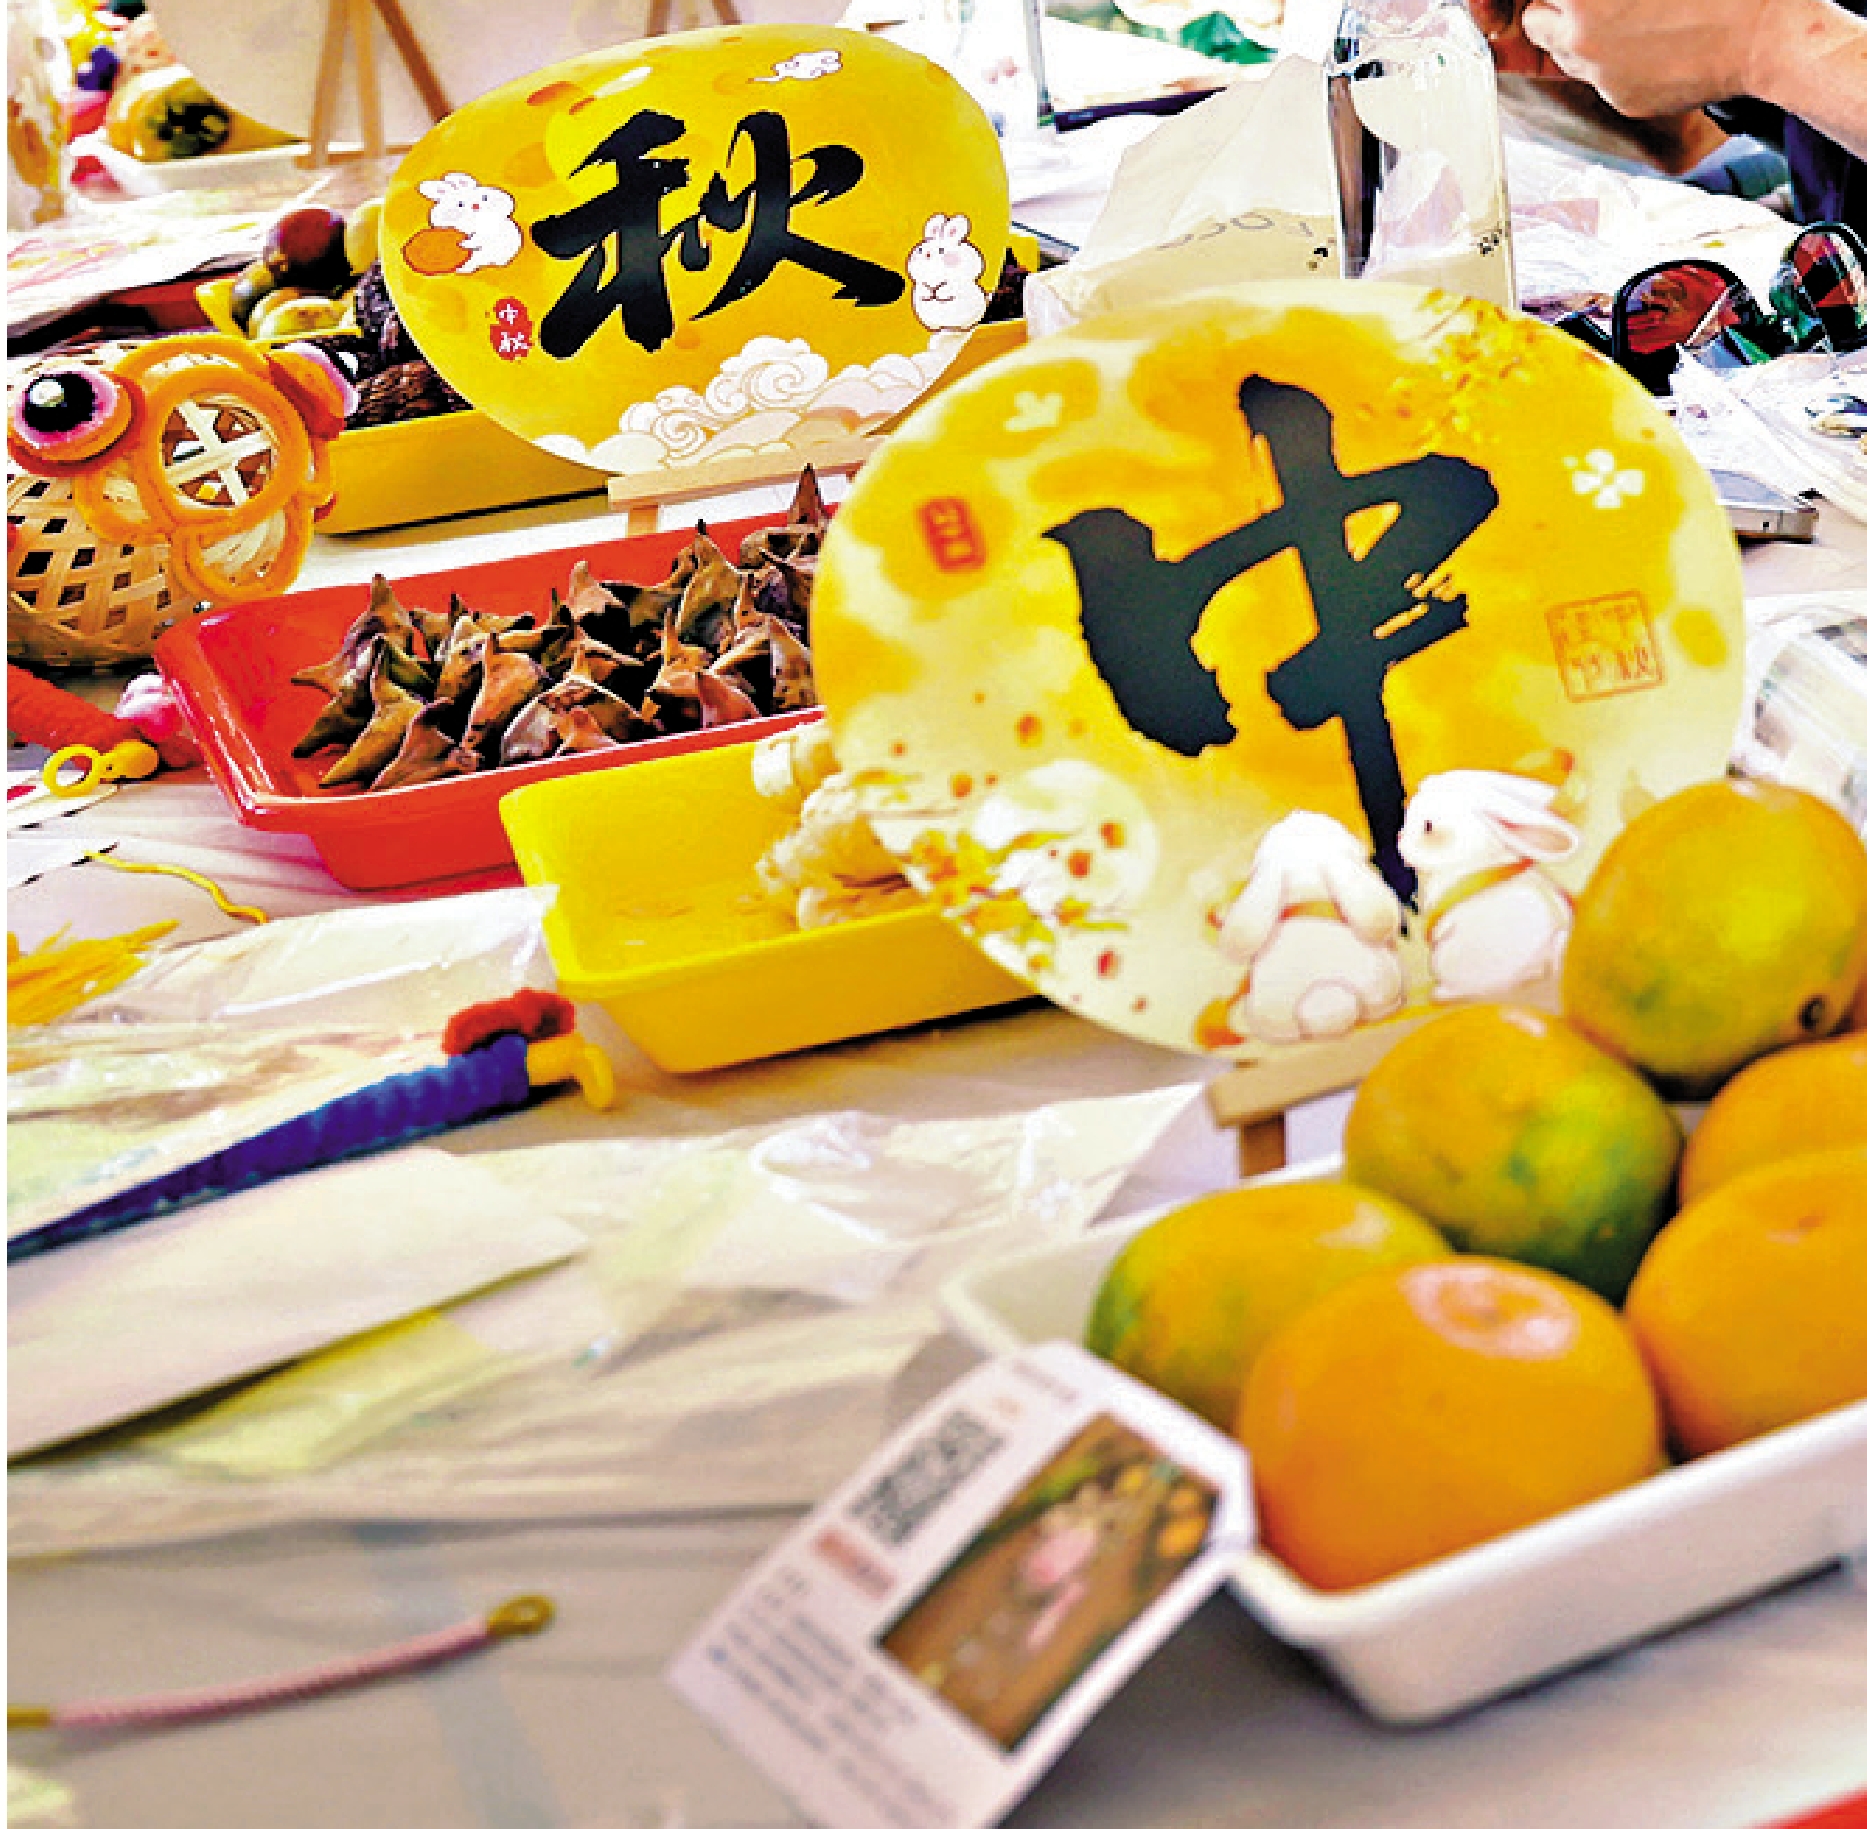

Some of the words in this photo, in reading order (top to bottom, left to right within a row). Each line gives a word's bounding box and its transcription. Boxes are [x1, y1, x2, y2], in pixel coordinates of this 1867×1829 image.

[498, 303, 528, 353] 中秋
[532, 109, 906, 358] 秋
[1041, 373, 1500, 936] 中
